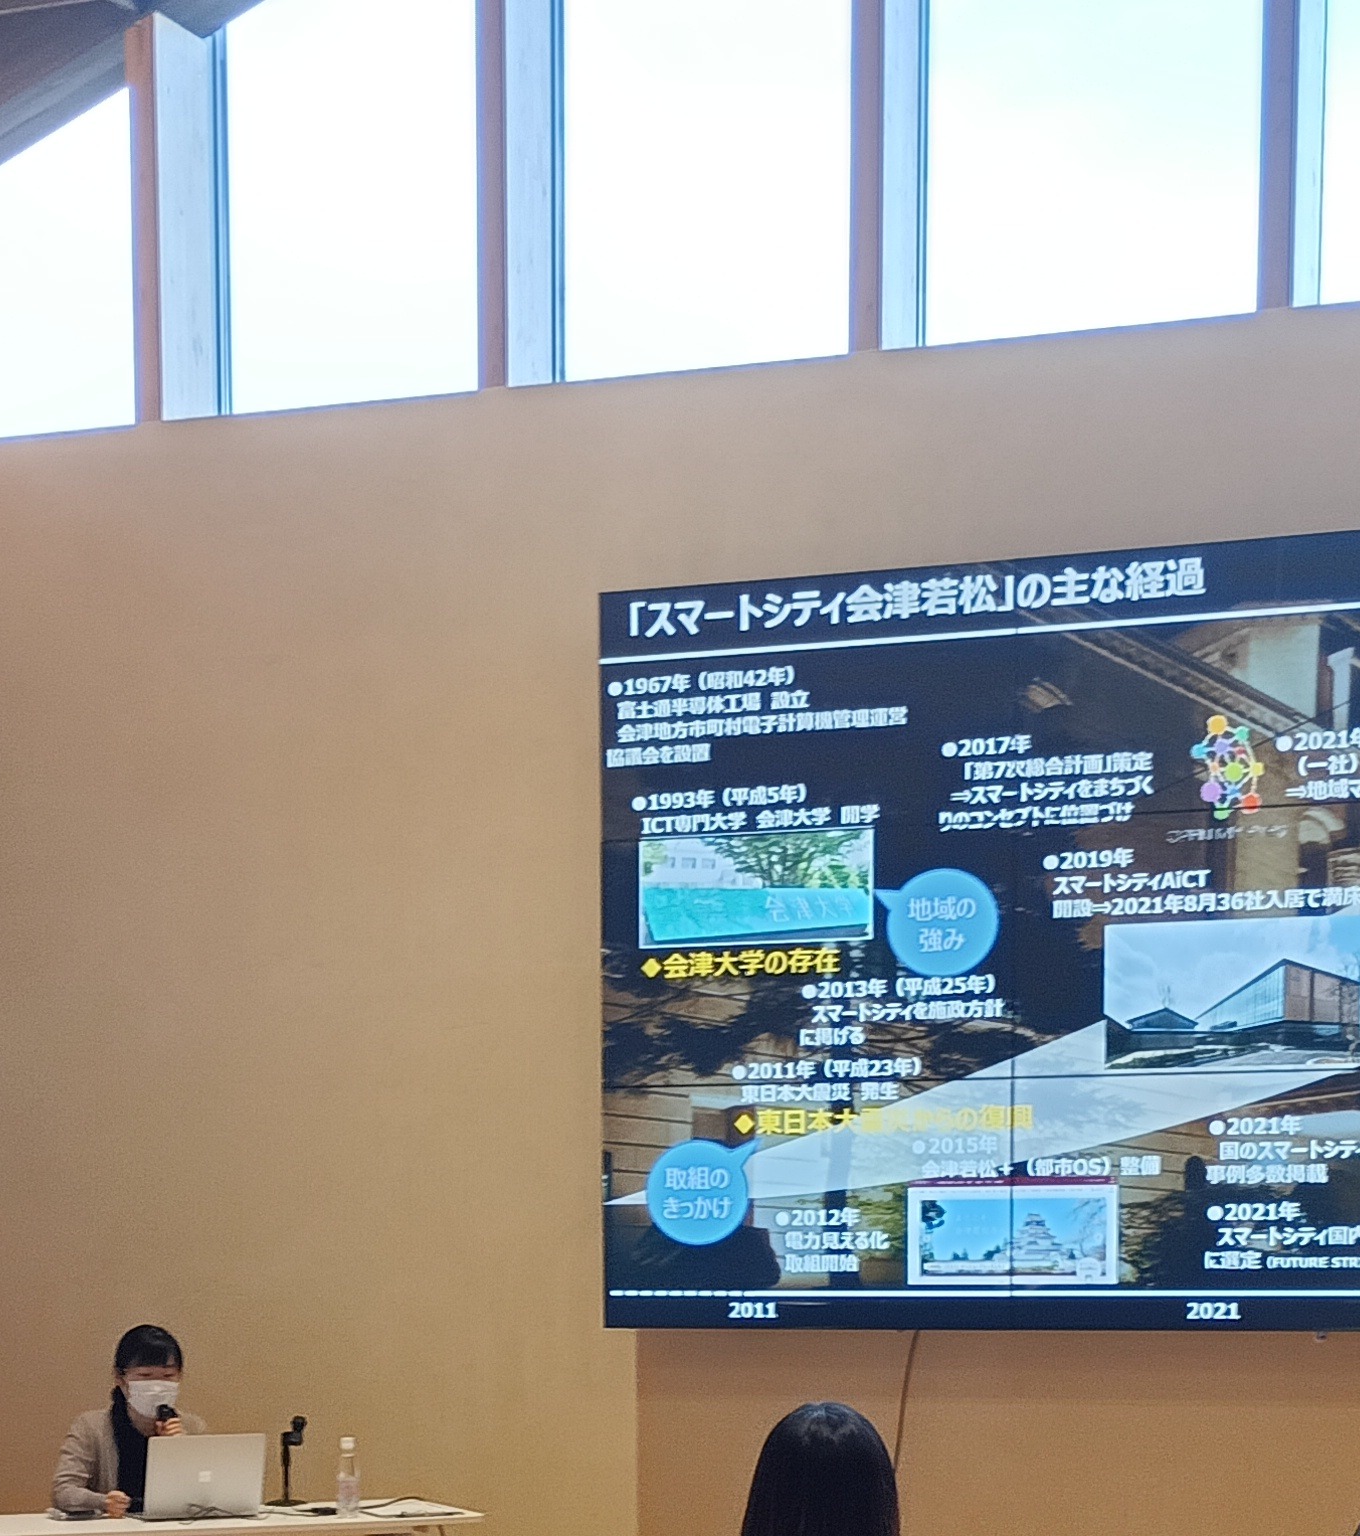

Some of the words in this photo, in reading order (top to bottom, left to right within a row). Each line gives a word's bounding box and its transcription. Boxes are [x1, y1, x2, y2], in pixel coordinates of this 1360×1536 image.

[628, 557, 1207, 638] 「スマートシティ会津若松」の主な経過
[770, 690, 810, 711] 設立
[958, 734, 1031, 756] 2017年
[642, 810, 746, 834] ICT専門大学
[756, 808, 831, 829] 会津大学
[1060, 848, 1134, 869] 2019年
[1053, 869, 1211, 894] スマートシティAiCT
[907, 896, 976, 919] 地域の
[919, 927, 966, 952] 強み
[662, 947, 841, 978] 会津大学の存在
[811, 998, 1002, 1023] スマートシティを施政方針
[800, 1027, 865, 1047] に掲げる
[741, 1082, 850, 1103] 東日本大震災
[861, 1081, 899, 1100] 発生
[1226, 1115, 1303, 1135] 2021年
[928, 1137, 998, 1154] 2015年
[665, 1167, 728, 1189] 取組の
[1206, 1163, 1329, 1184] 事例多数掲載
[663, 1197, 732, 1219] きっかけ
[791, 1207, 861, 1226] 2012年
[1224, 1201, 1301, 1221] 2021年
[785, 1231, 891, 1250] 電力見える化
[785, 1254, 860, 1272] 取組開始
[728, 1302, 779, 1319] 2011
[1186, 1302, 1241, 1320] 2021
